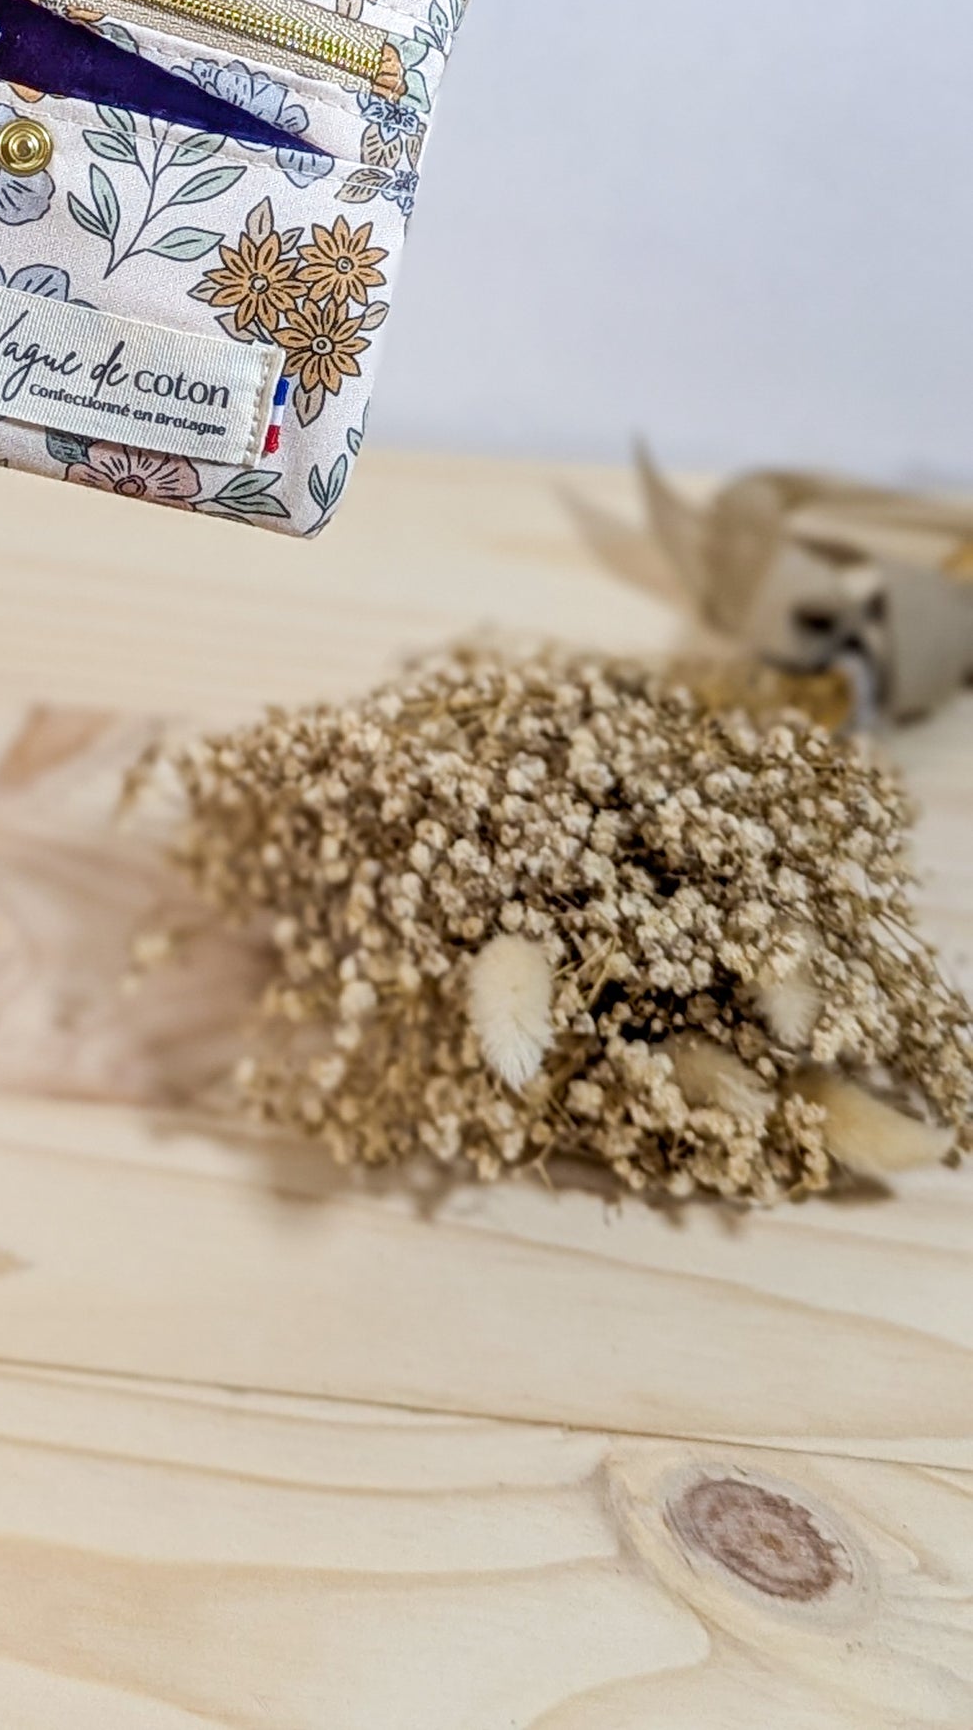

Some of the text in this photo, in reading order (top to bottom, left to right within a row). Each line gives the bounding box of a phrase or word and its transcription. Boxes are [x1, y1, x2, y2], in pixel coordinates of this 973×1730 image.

[90, 340, 129, 397] de
[134, 370, 230, 409] coton
[29, 383, 227, 436] Confectionné en Bretagne
